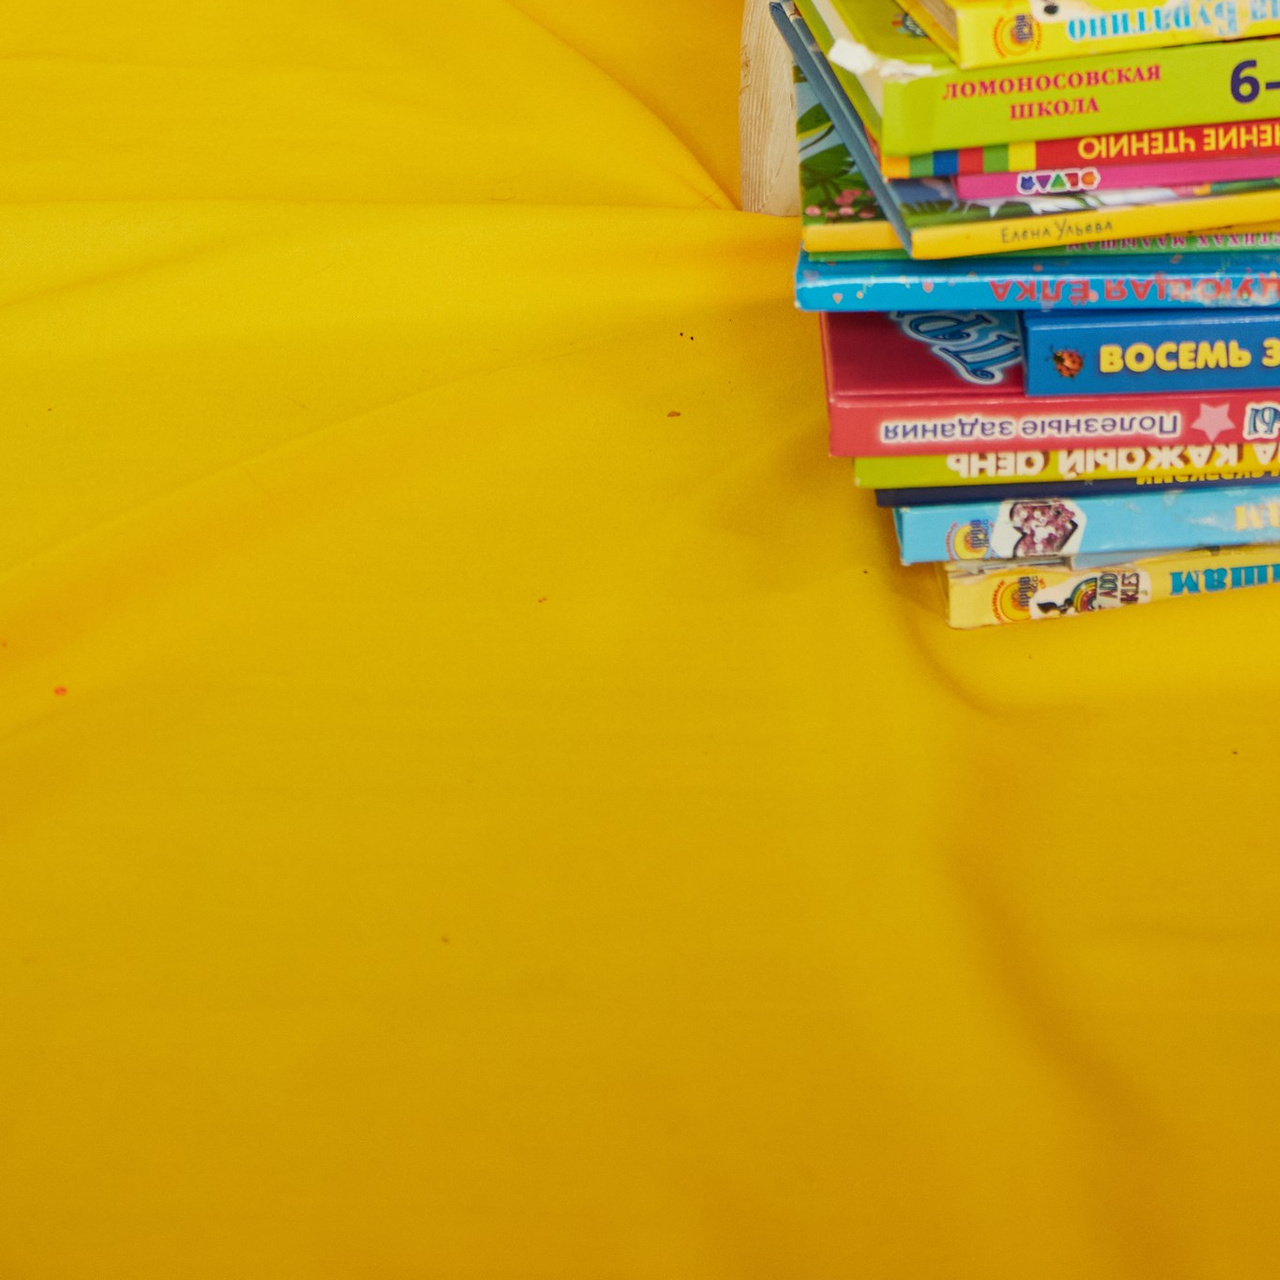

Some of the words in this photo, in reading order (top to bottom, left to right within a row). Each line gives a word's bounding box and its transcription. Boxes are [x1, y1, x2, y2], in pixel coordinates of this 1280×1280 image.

[942, 64, 1162, 100] ЛОМОНОСОВСКАЯ
[1009, 97, 1100, 120] ШКОЛА
[1078, 129, 1197, 160] ЧТЕНИЮ
[988, 278, 1091, 306] ЁЛКА
[1099, 339, 1253, 373] ВОСЕМЬ
[880, 416, 1014, 443] задания
[1021, 413, 1180, 441] Полезные
